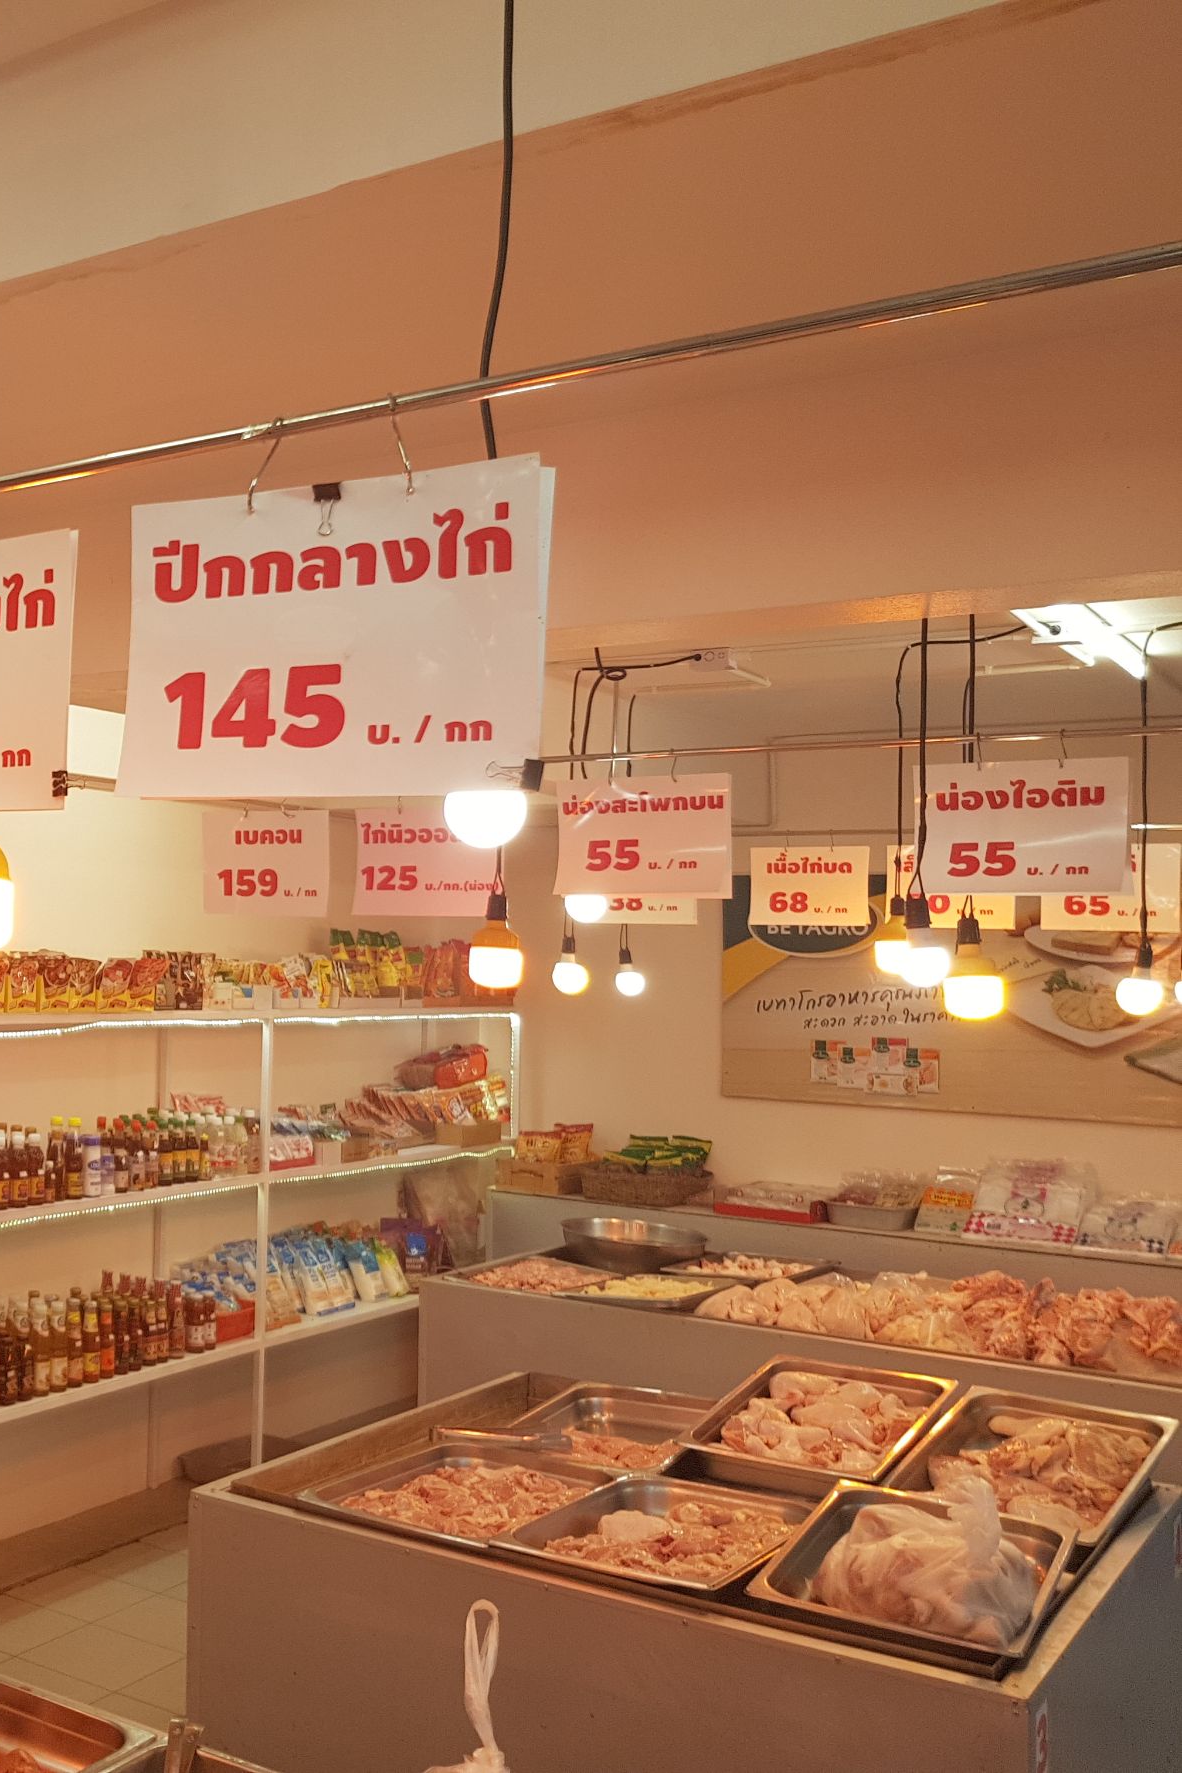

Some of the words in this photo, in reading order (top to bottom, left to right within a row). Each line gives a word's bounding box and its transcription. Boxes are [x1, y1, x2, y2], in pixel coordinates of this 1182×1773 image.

[153, 502, 513, 604] ปีกกลางไก่
[164, 663, 347, 750] 145
[368, 725, 400, 745] บ.
[445, 720, 493, 743] กก
[562, 791, 725, 816] น่องสะโพกบน
[936, 779, 1105, 811] น่องไอติม
[235, 829, 302, 845] เบคอน
[585, 839, 641, 872] 55
[766, 852, 853, 874] เนื้อไก่บด
[947, 841, 1017, 877] 55
[217, 868, 278, 897] 159
[361, 865, 419, 892] 125
[769, 891, 809, 913] 68
[1063, 895, 1111, 916] 65
